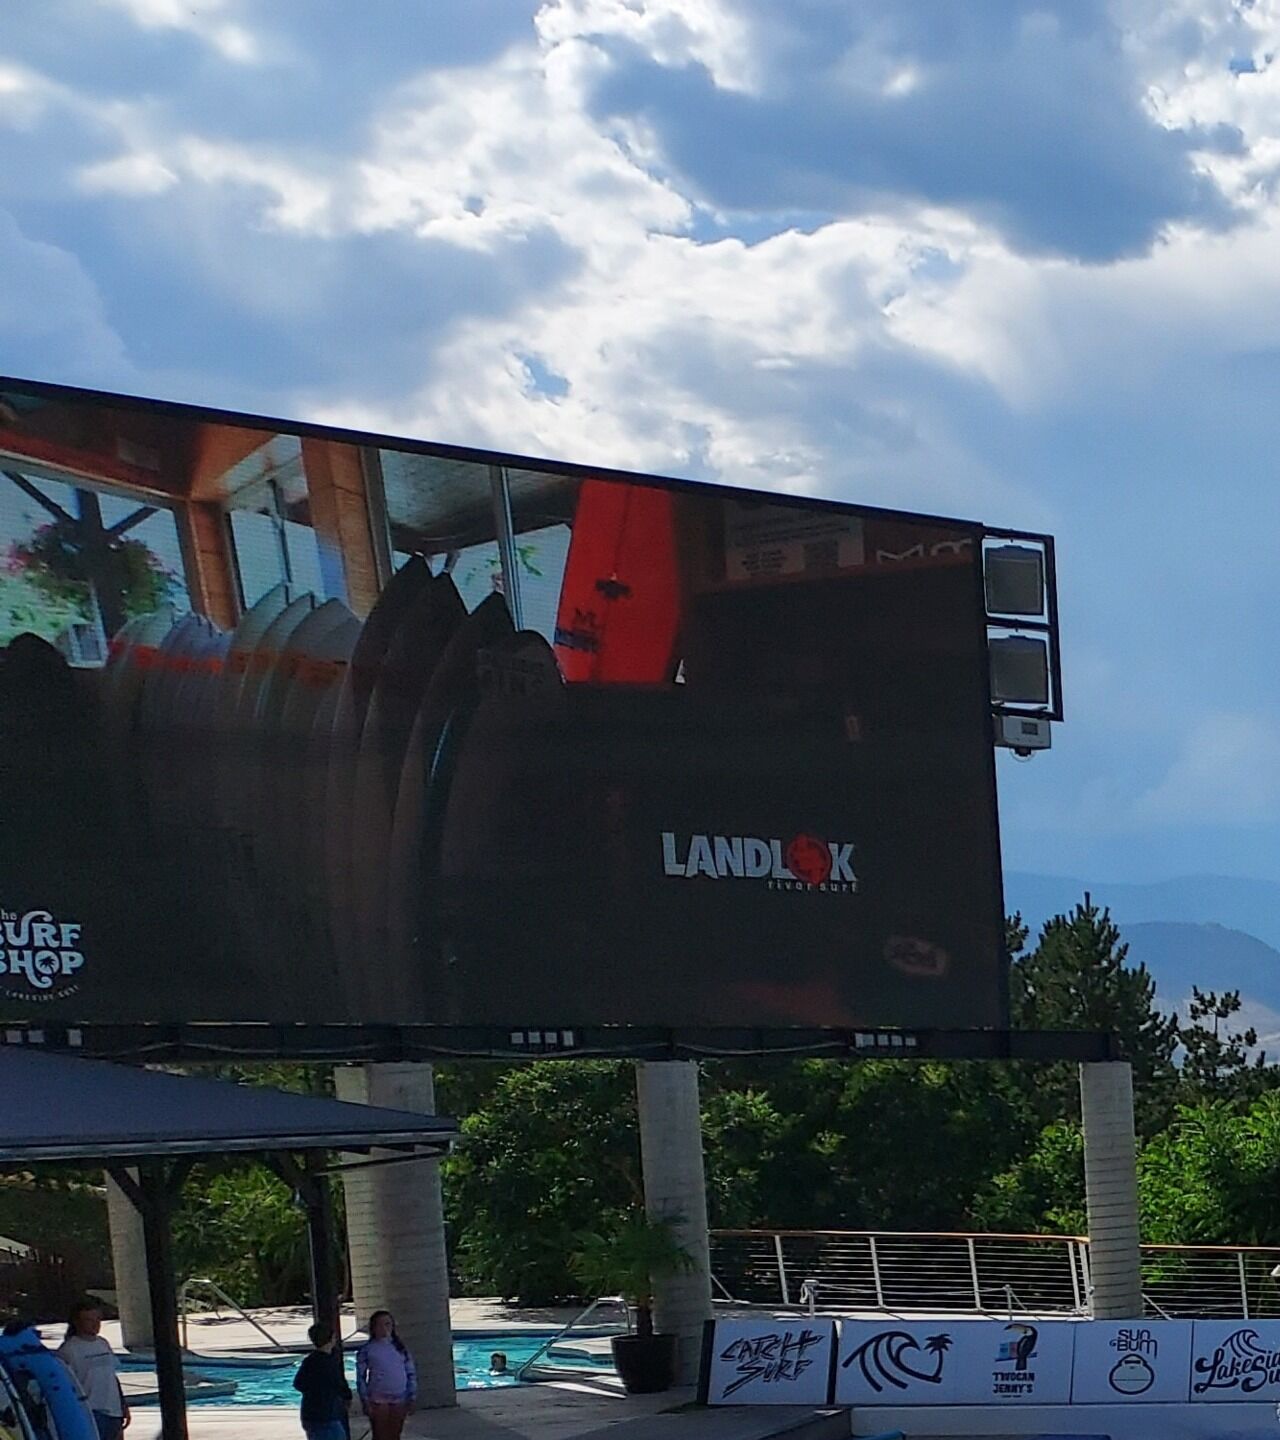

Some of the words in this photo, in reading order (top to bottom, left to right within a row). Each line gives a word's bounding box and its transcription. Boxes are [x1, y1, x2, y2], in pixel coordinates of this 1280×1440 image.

[0, 908, 17, 920] he
[720, 1330, 825, 1361] CATCH
[722, 1358, 814, 1398] SURF
